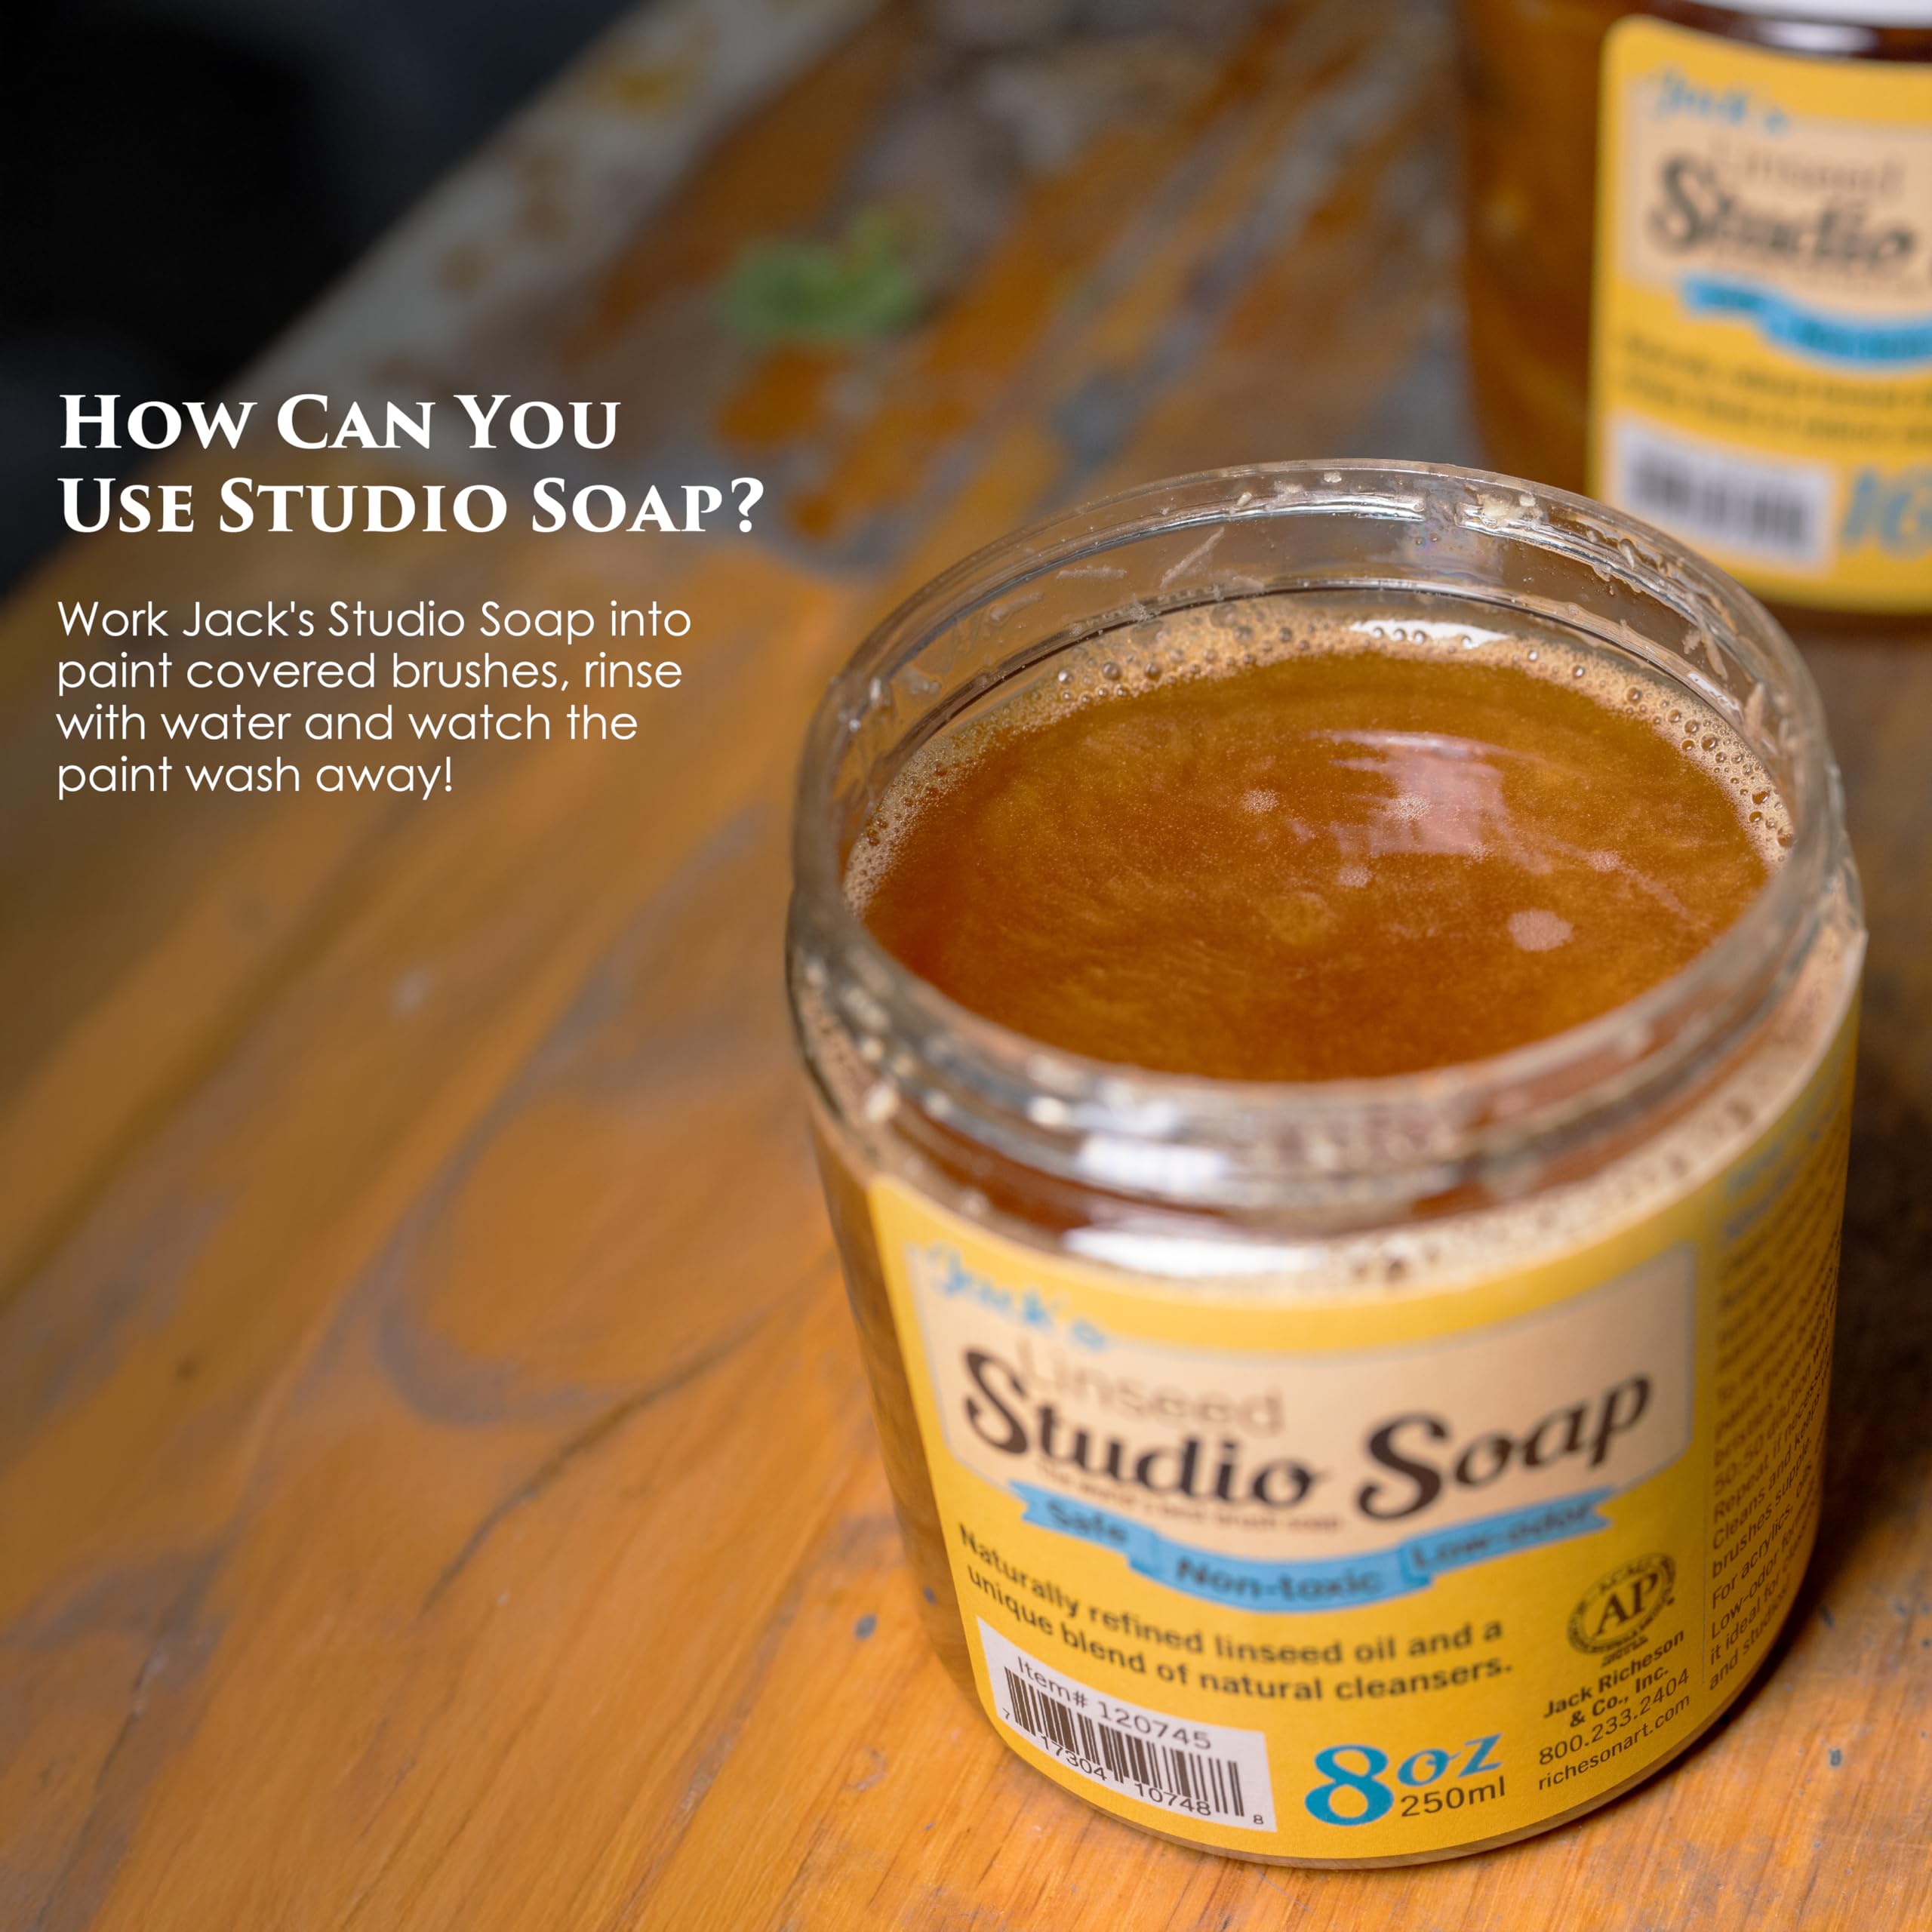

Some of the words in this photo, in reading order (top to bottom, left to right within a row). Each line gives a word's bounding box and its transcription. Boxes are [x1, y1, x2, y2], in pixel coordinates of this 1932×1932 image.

[963, 1343, 1331, 1508] Studio
[1355, 1372, 1653, 1521] Soap
[1018, 1336, 1284, 1435] Linseed
[1048, 1498, 1129, 1543] Safe
[1712, 1487, 1765, 1550] Cleans
[1768, 1442, 1792, 1491] and
[1714, 1453, 1769, 1524] Repeat
[1175, 1556, 1384, 1601] Non-toxic
[1712, 1503, 1772, 1579] brushes
[1712, 1570, 1738, 1609] For
[1741, 1504, 1794, 1580] acrylics,
[960, 1522, 1079, 1617] Naturally
[1089, 1604, 1204, 1654] refined
[1214, 1633, 1343, 1663] linseed
[1354, 1636, 1396, 1661] oil
[1408, 1622, 1472, 1657] and
[1483, 1620, 1503, 1641] a
[968, 1564, 1054, 1635] unique
[1061, 1623, 1146, 1674] blend
[1157, 1663, 1189, 1685] of
[1200, 1671, 1322, 1701] natural
[1335, 1657, 1512, 1701] cleansers.
[1594, 1571, 1660, 1637] AP
[1710, 1644, 1721, 1665] it
[1725, 1597, 1761, 1651] ideal
[1764, 1570, 1780, 1601] for
[1712, 1549, 1780, 1639] Low-odor
[1017, 1656, 1088, 1709] Item#
[1099, 1701, 1211, 1750] 120745
[1543, 1686, 1592, 1718] Jack
[1598, 1630, 1684, 1694] Richeson
[1570, 1710, 1586, 1727] &
[1592, 1696, 1629, 1717] Co.,
[1635, 1665, 1669, 1694] Inc.
[1709, 1648, 1738, 1690] and
[1538, 1694, 1690, 1791] richesonart.com
[1539, 1667, 1690, 1766] 800.233.2404
[1002, 1708, 1011, 1721] 7
[1040, 1735, 1107, 1782] 17304
[1134, 1783, 1211, 1817] 10748
[1253, 1814, 1264, 1825] 8
[1400, 1776, 1506, 1818] 250ml
